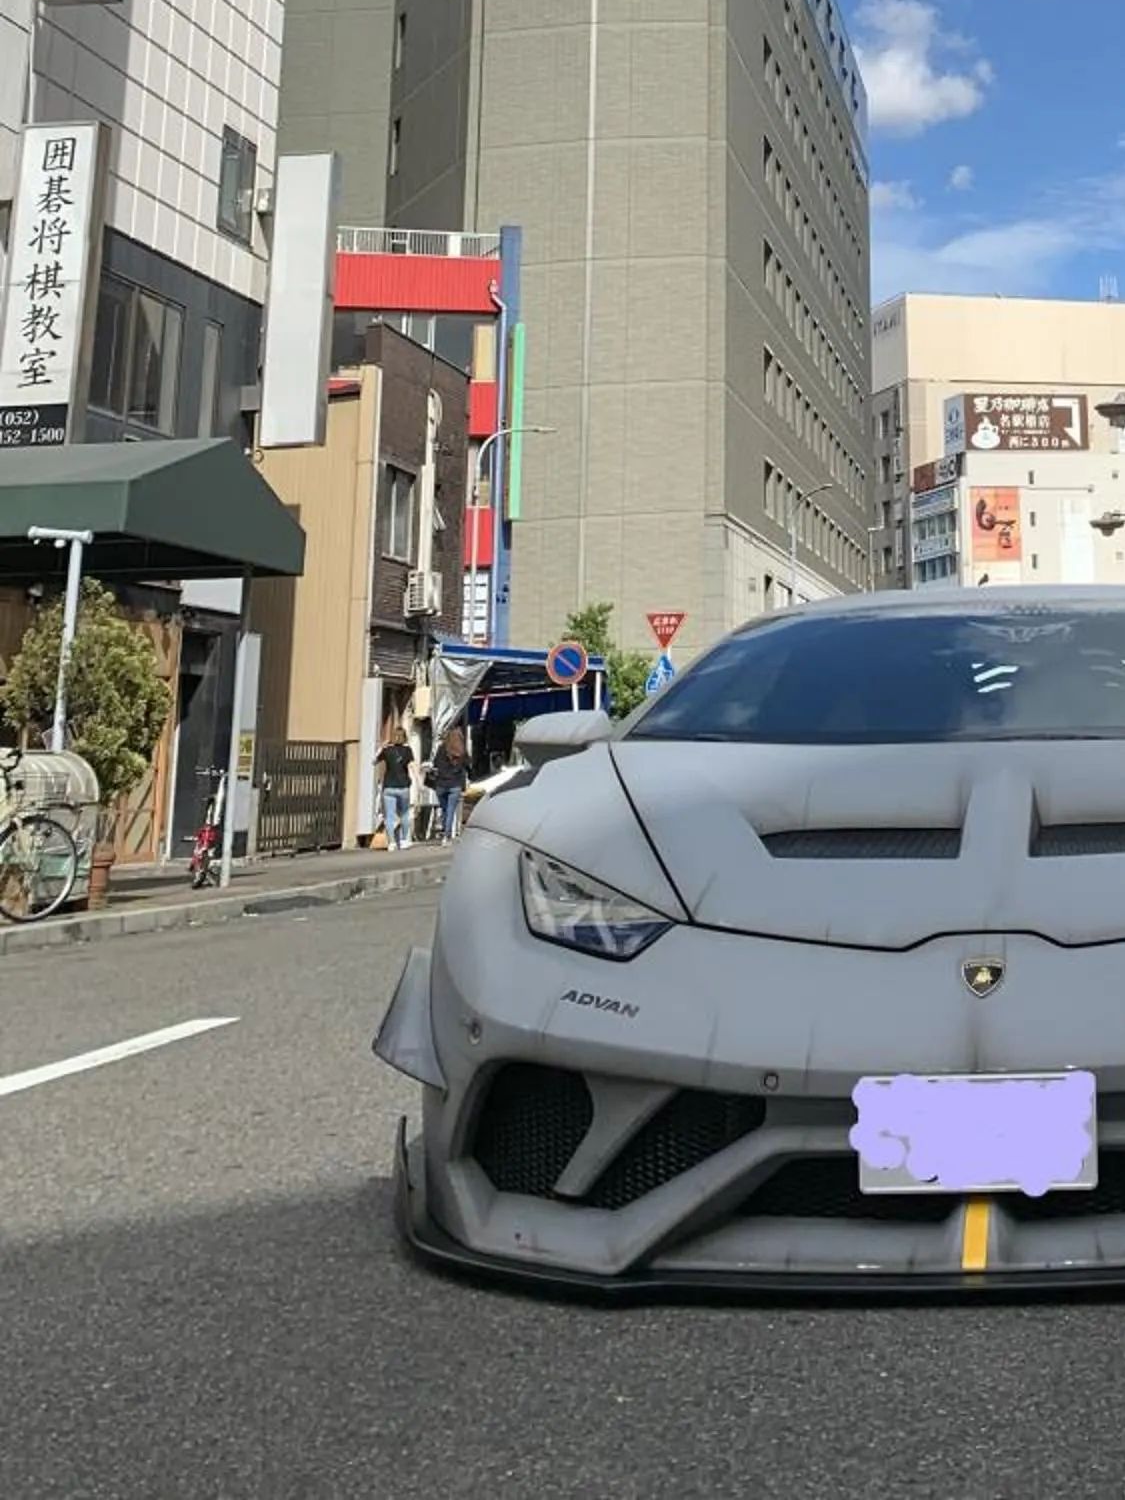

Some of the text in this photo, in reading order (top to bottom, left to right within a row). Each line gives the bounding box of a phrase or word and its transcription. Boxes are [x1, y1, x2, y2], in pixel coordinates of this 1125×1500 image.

[17, 137, 77, 389] 囲碁将棋教室
[1, 409, 39, 426] (052)
[0, 428, 64, 444] 52-1500
[560, 990, 640, 1018] ADVAN
